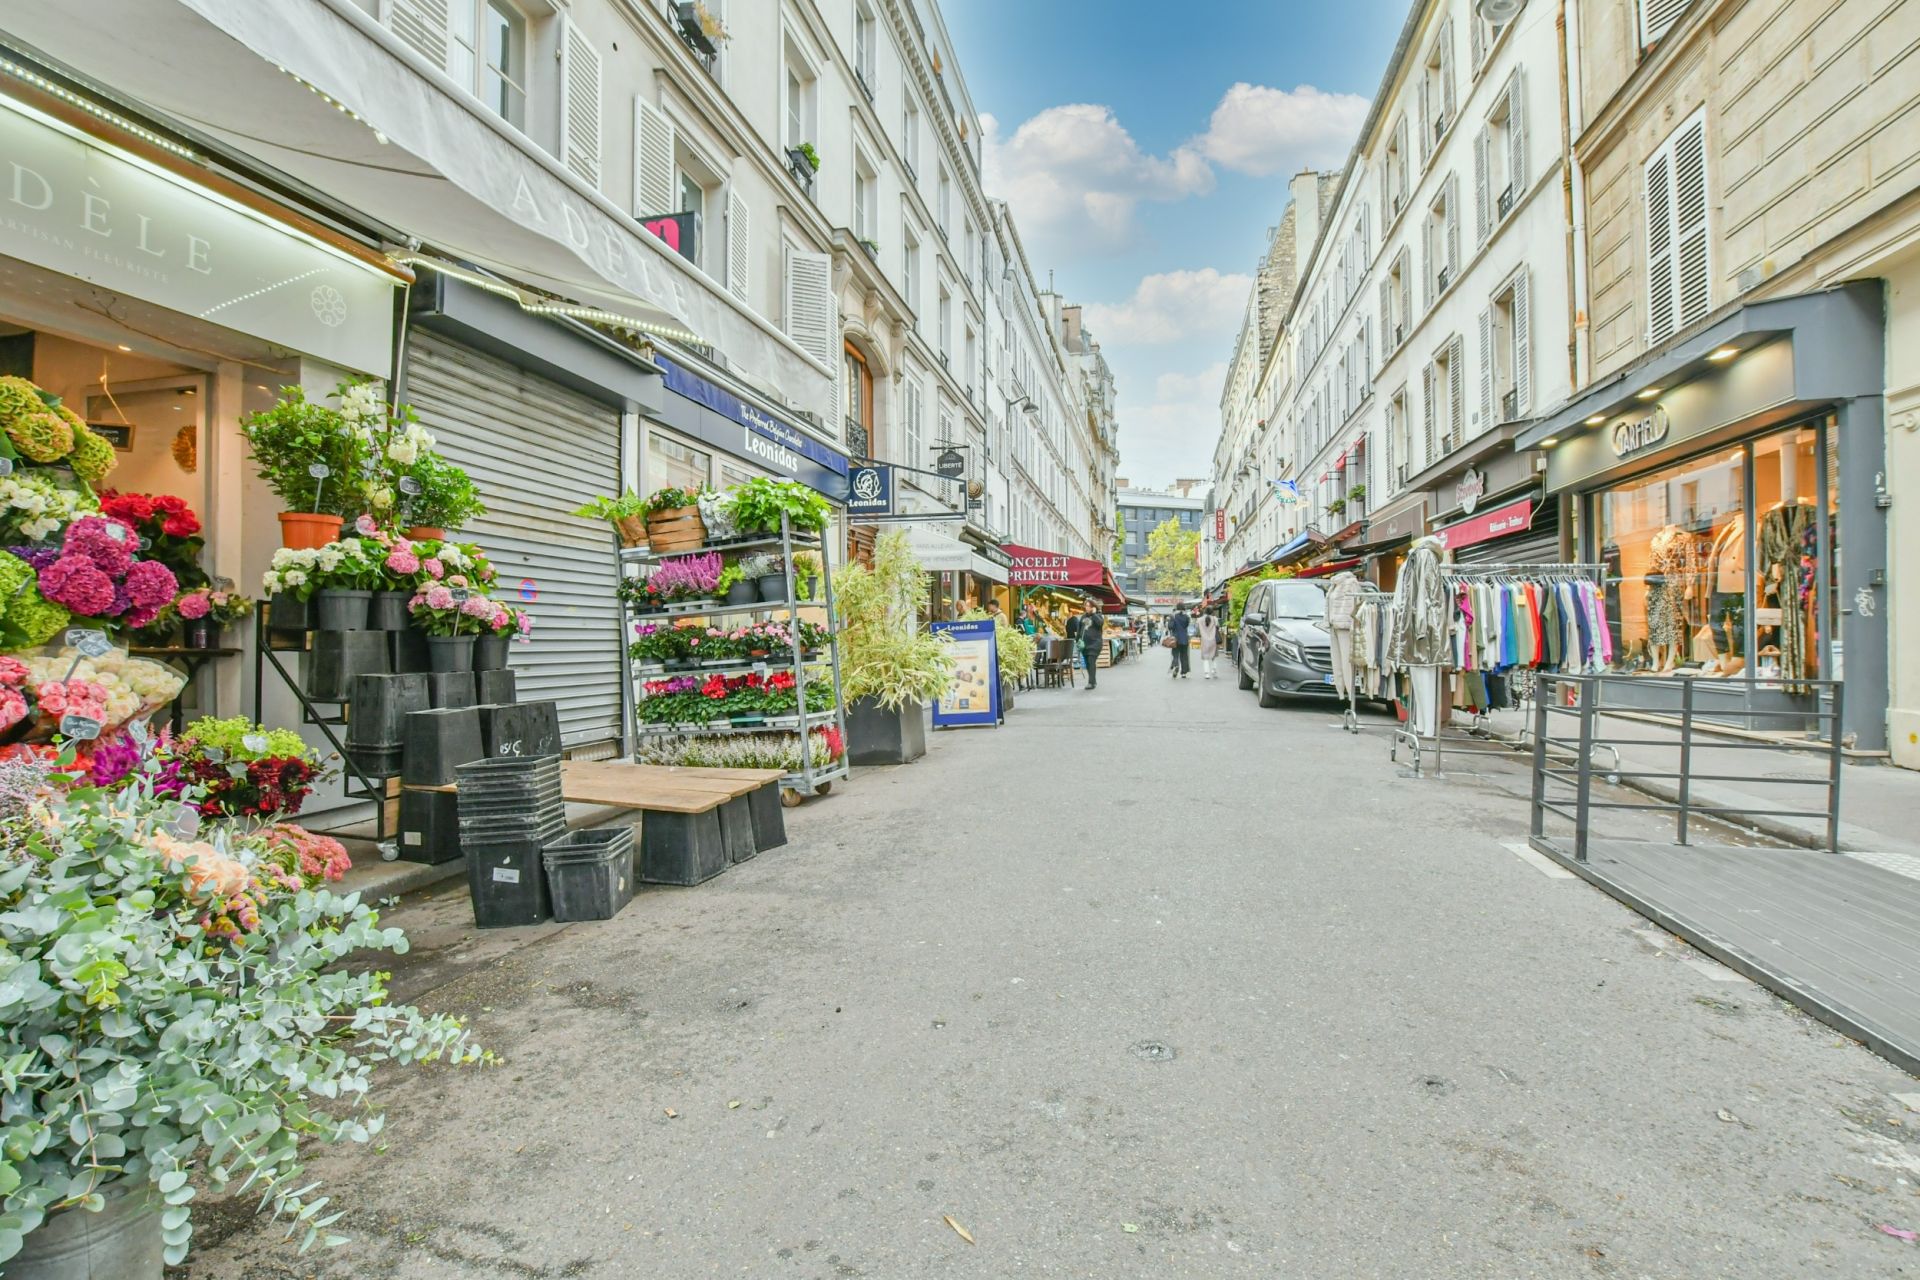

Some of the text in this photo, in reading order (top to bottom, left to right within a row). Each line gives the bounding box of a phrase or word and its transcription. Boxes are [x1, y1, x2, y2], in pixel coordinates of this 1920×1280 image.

[82, 245, 169, 283] FLEURISTE
[744, 426, 799, 473] Leonidas
[1611, 404, 1669, 457] GARFIELD
[849, 498, 887, 508] Leonidas
[947, 624, 979, 632] Leonidas
